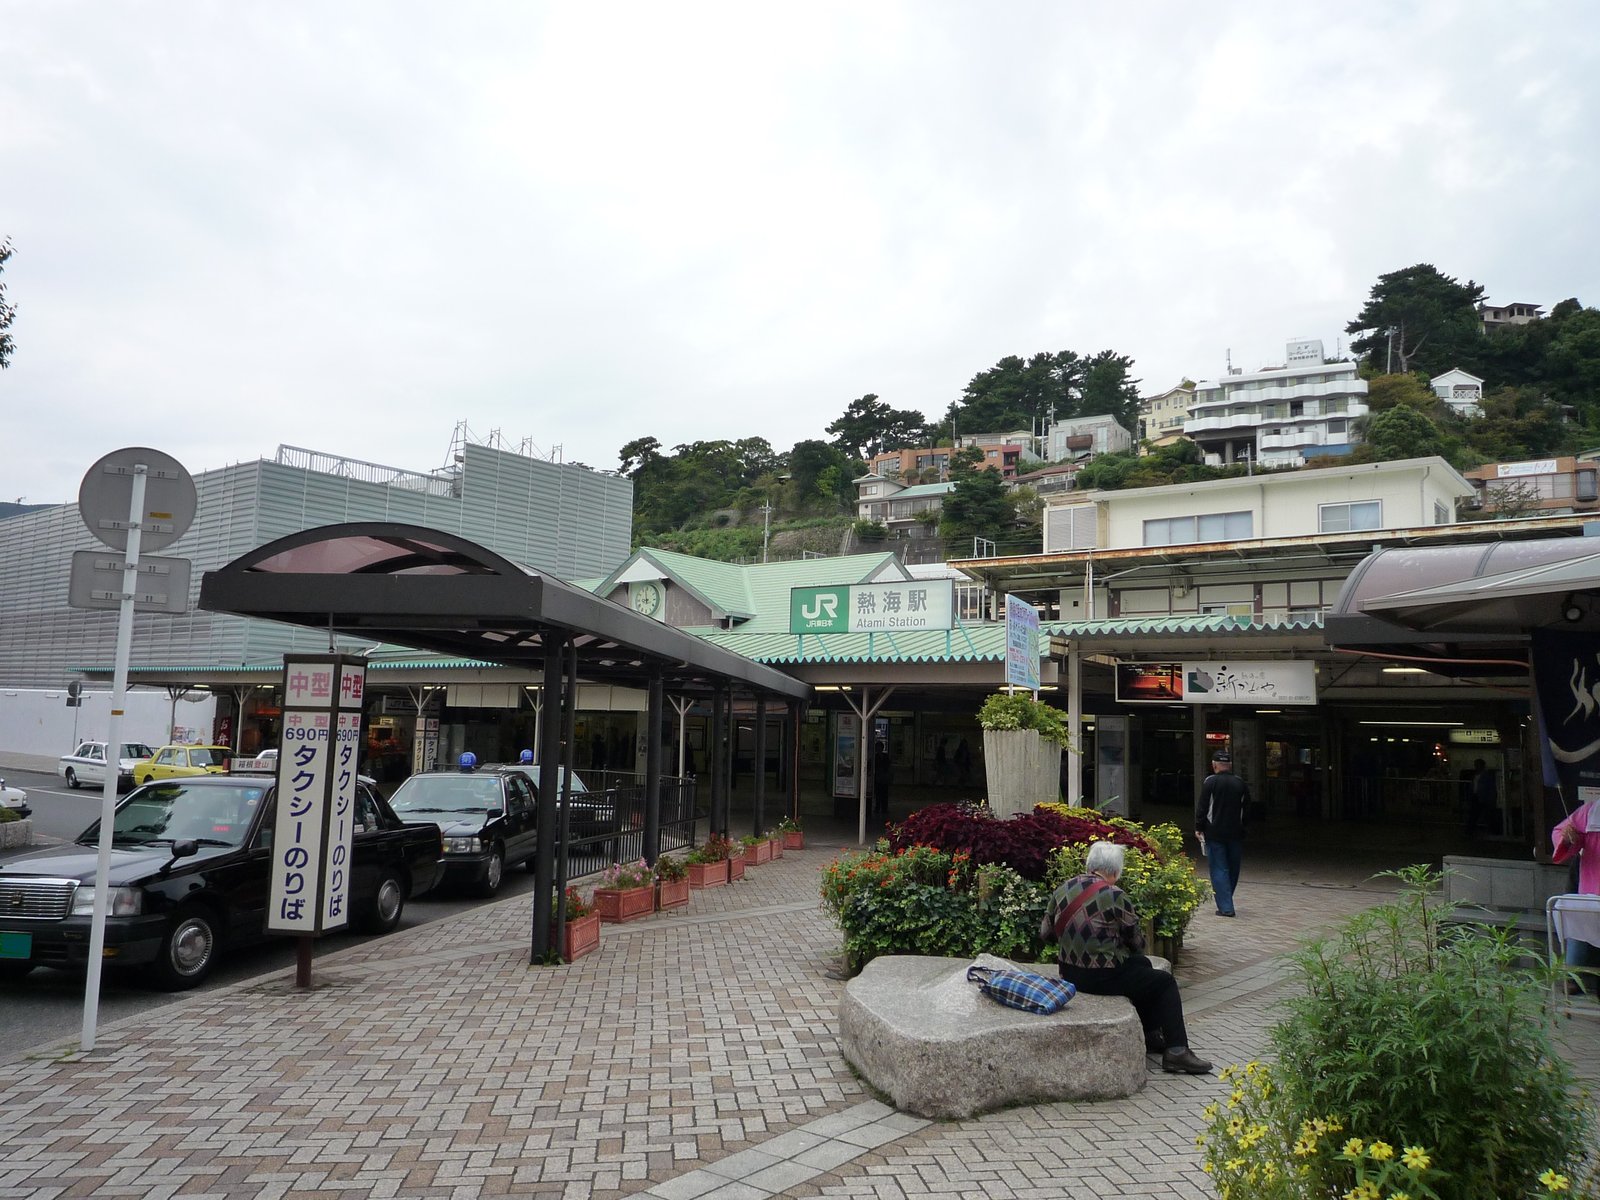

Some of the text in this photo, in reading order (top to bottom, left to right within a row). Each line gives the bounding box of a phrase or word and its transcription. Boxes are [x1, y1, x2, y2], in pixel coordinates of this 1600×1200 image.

[802, 593, 838, 619] JR
[857, 589, 927, 614] 熱海駅
[857, 616, 926, 628] Atami Station
[290, 671, 331, 699] 中型
[341, 672, 363, 700] 中型
[288, 715, 329, 728] 中型
[338, 715, 360, 728] 中型
[285, 727, 329, 742] 690円
[336, 727, 359, 742] 690円
[280, 744, 317, 920] タクシーのりば
[329, 744, 352, 918] タクシーのりば
